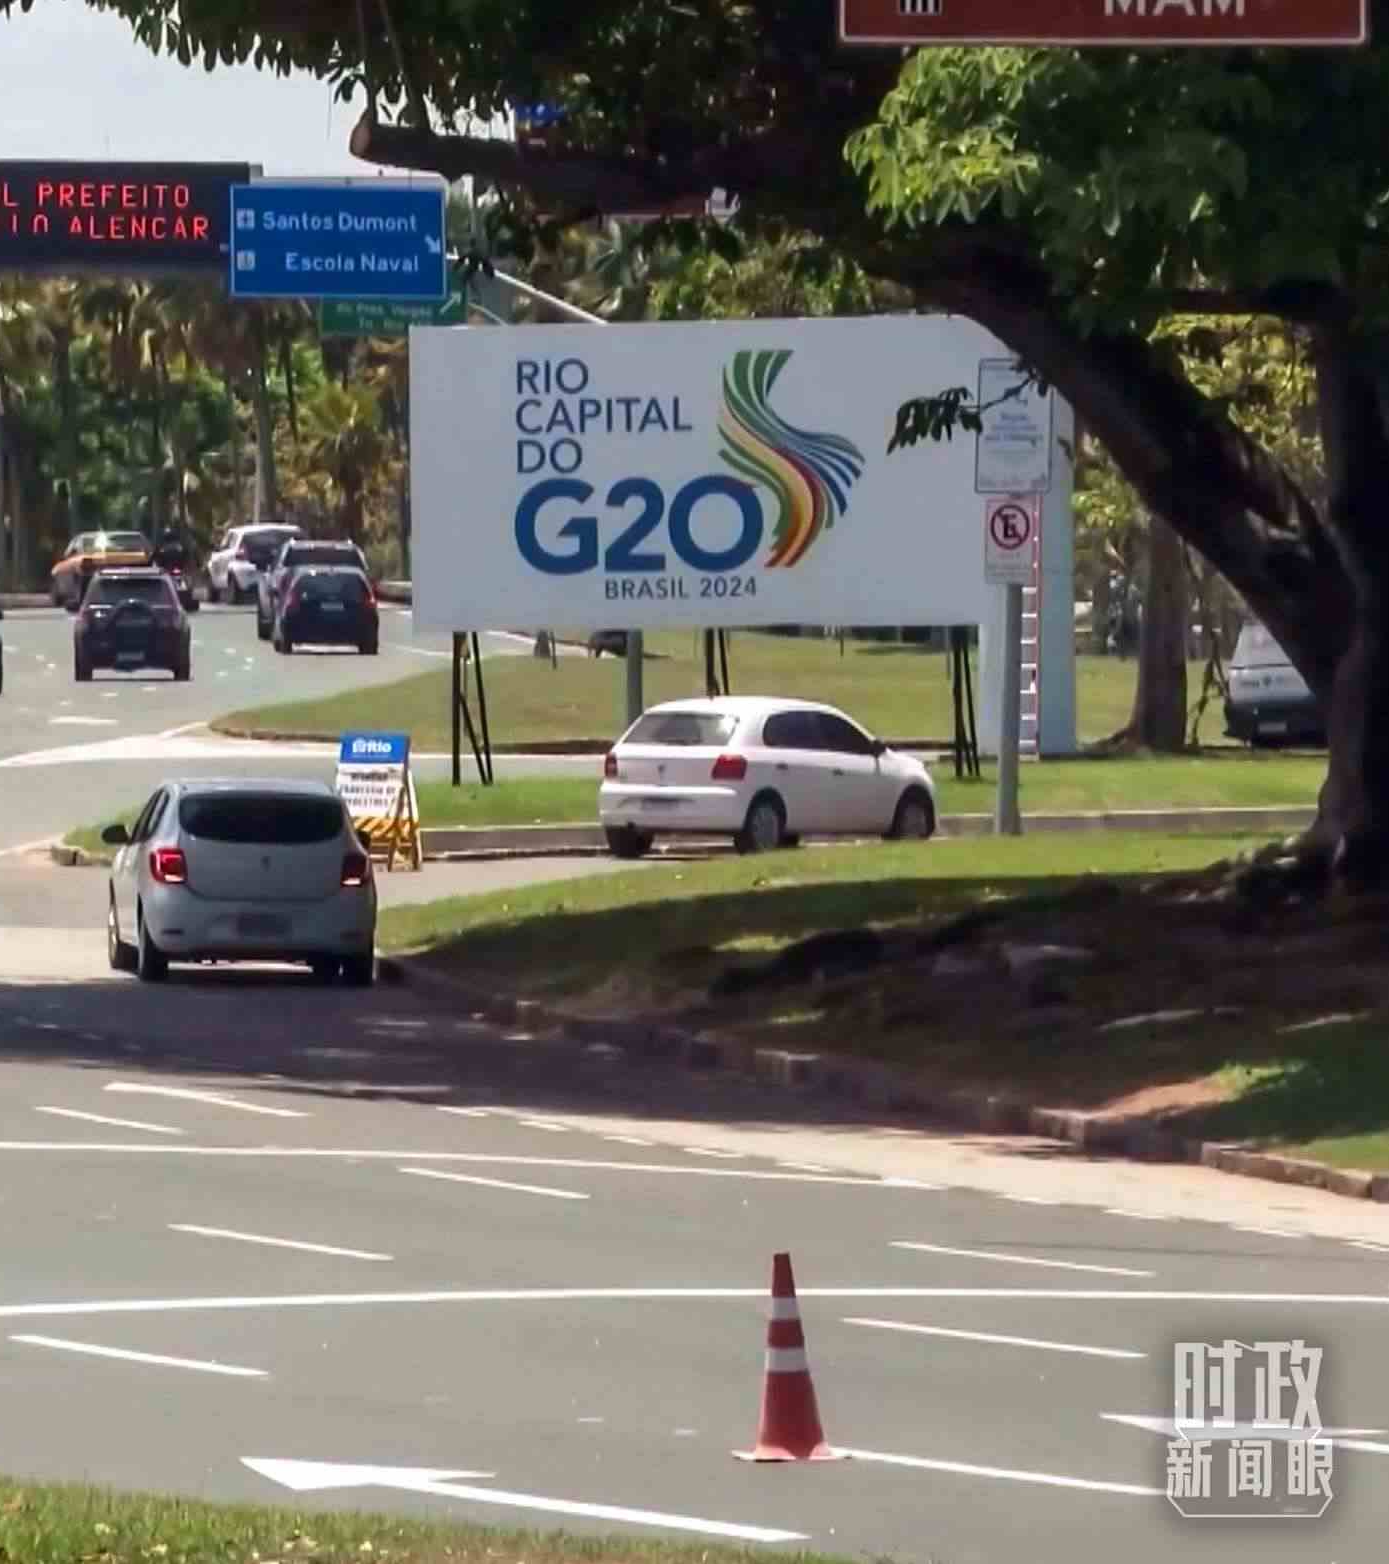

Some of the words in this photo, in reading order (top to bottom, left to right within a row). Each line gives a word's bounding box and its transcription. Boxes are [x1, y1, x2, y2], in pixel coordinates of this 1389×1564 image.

[38, 182, 190, 208] PREFEITO
[69, 214, 210, 240] ALENCAR
[263, 211, 333, 231] Santos
[338, 211, 418, 232] Dumont
[285, 252, 355, 272] Escola
[360, 253, 420, 272] Naval
[515, 358, 589, 395] RIO
[515, 396, 693, 434] CAPITAL
[516, 438, 583, 474] DO
[514, 475, 764, 576] G20
[605, 577, 690, 600] BRASIL
[700, 576, 757, 598] 2024
